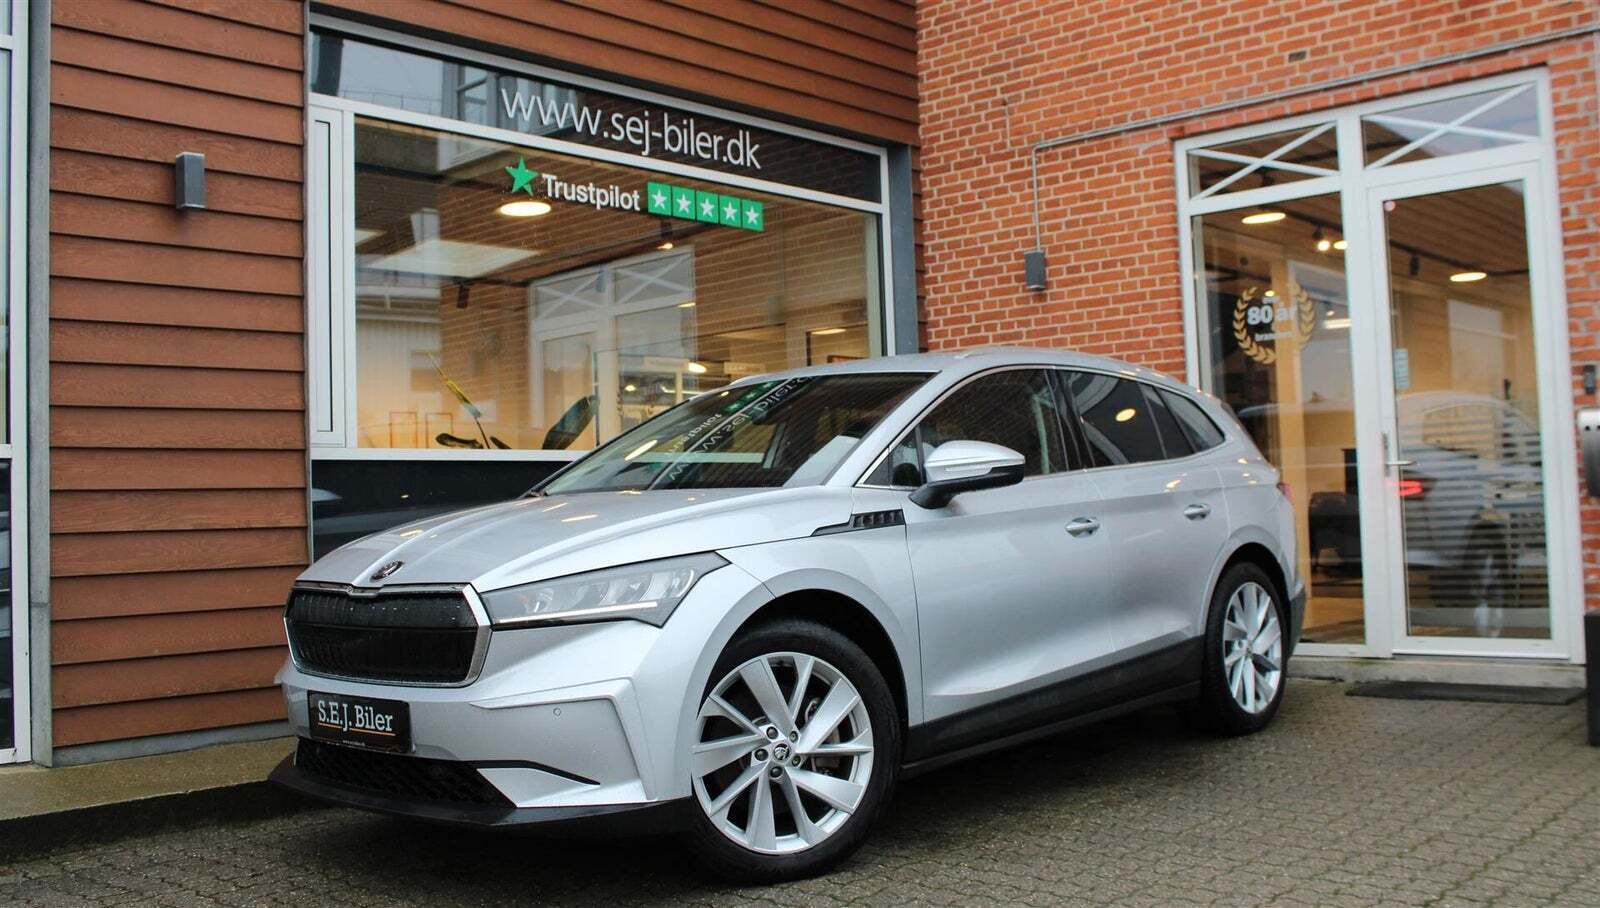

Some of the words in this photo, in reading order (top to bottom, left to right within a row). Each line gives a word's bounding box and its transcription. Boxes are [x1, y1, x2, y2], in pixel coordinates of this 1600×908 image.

[501, 88, 762, 169] www.sej-biler.dk
[542, 173, 641, 211] Trustpilot
[1247, 305, 1273, 325] 80
[318, 700, 352, 732] S.E.J.
[355, 705, 393, 732] Biler
